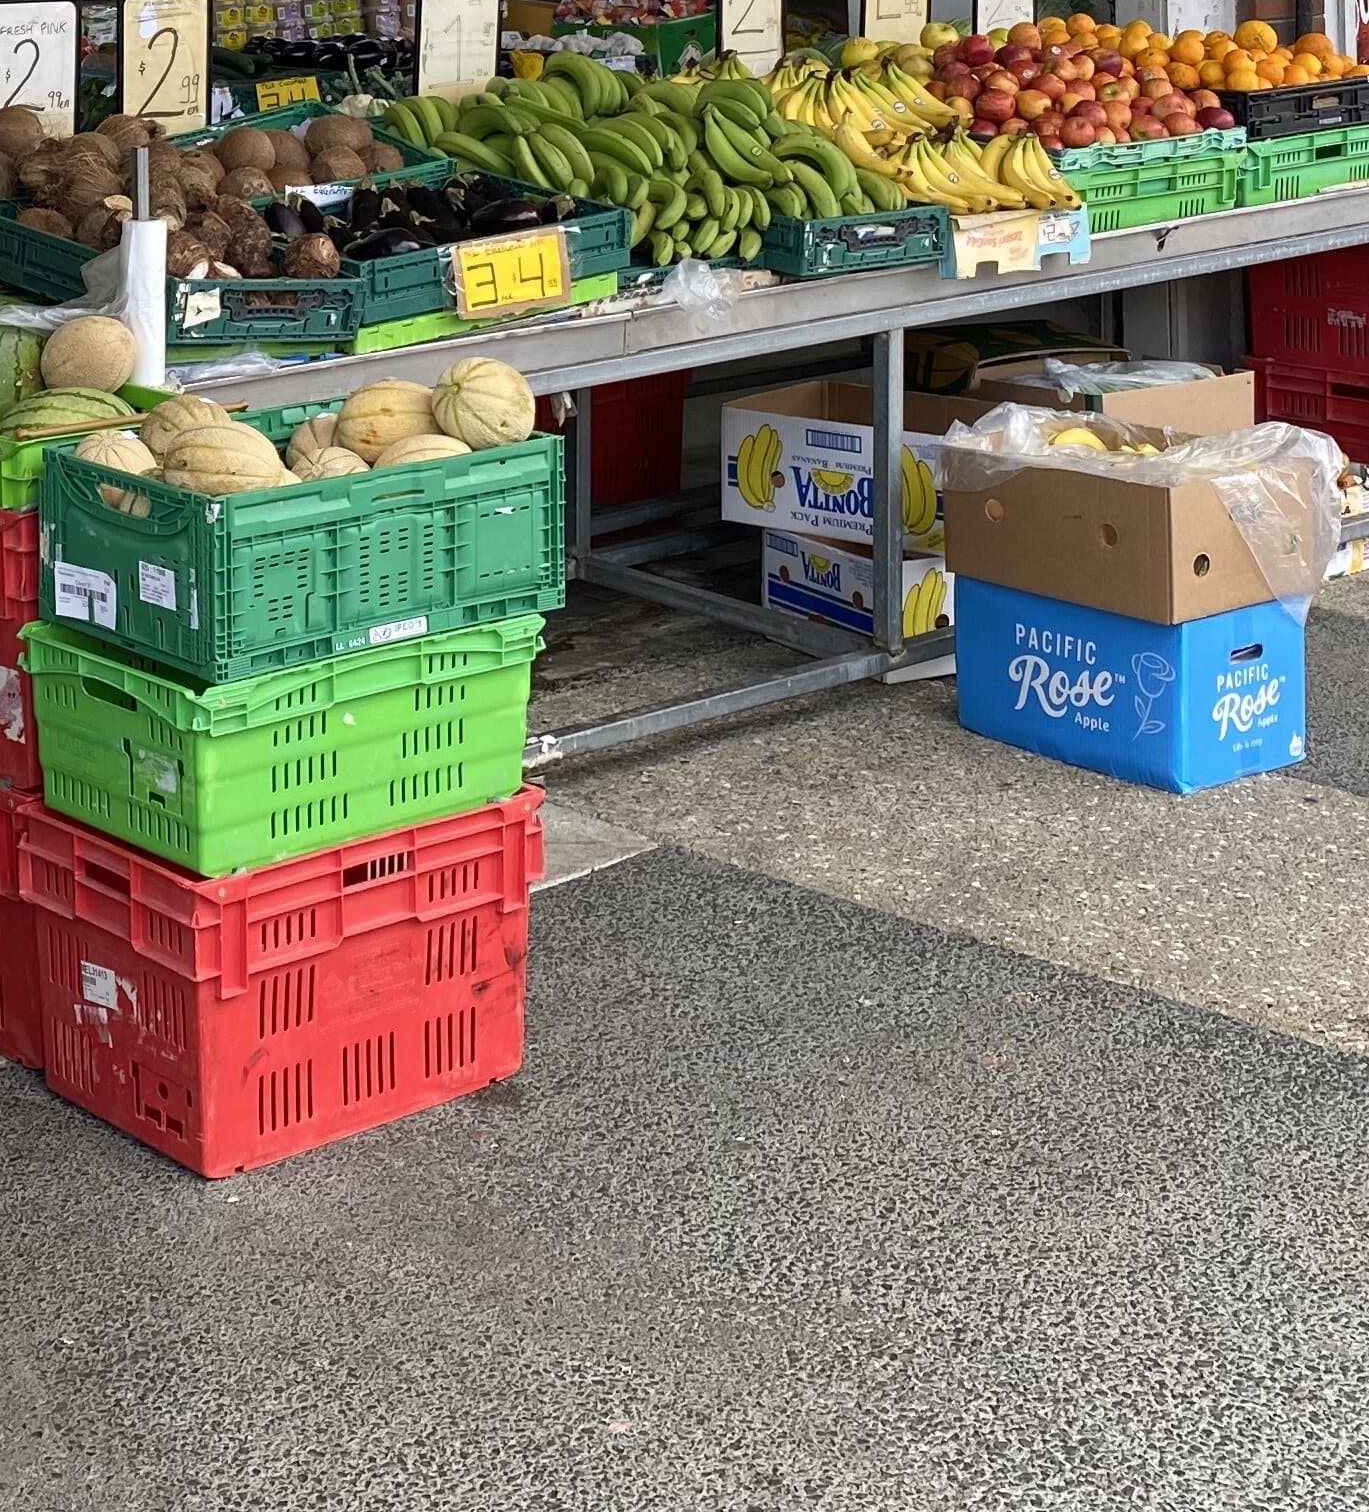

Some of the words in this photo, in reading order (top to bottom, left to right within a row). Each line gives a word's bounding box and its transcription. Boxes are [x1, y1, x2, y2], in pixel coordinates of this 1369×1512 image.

[0, 24, 32, 36] FRESH
[791, 454, 829, 469] BANANAS
[835, 461, 873, 476] PREMIUM
[789, 465, 874, 518] BONITA
[790, 511, 820, 527] PACK
[822, 516, 874, 536] PREMIUM
[799, 551, 842, 593] BONITA
[1015, 622, 1098, 666] PACIFIC
[1216, 662, 1270, 693] PACIFIC
[1073, 711, 1111, 733] Apple
[1256, 712, 1279, 729] Apple
